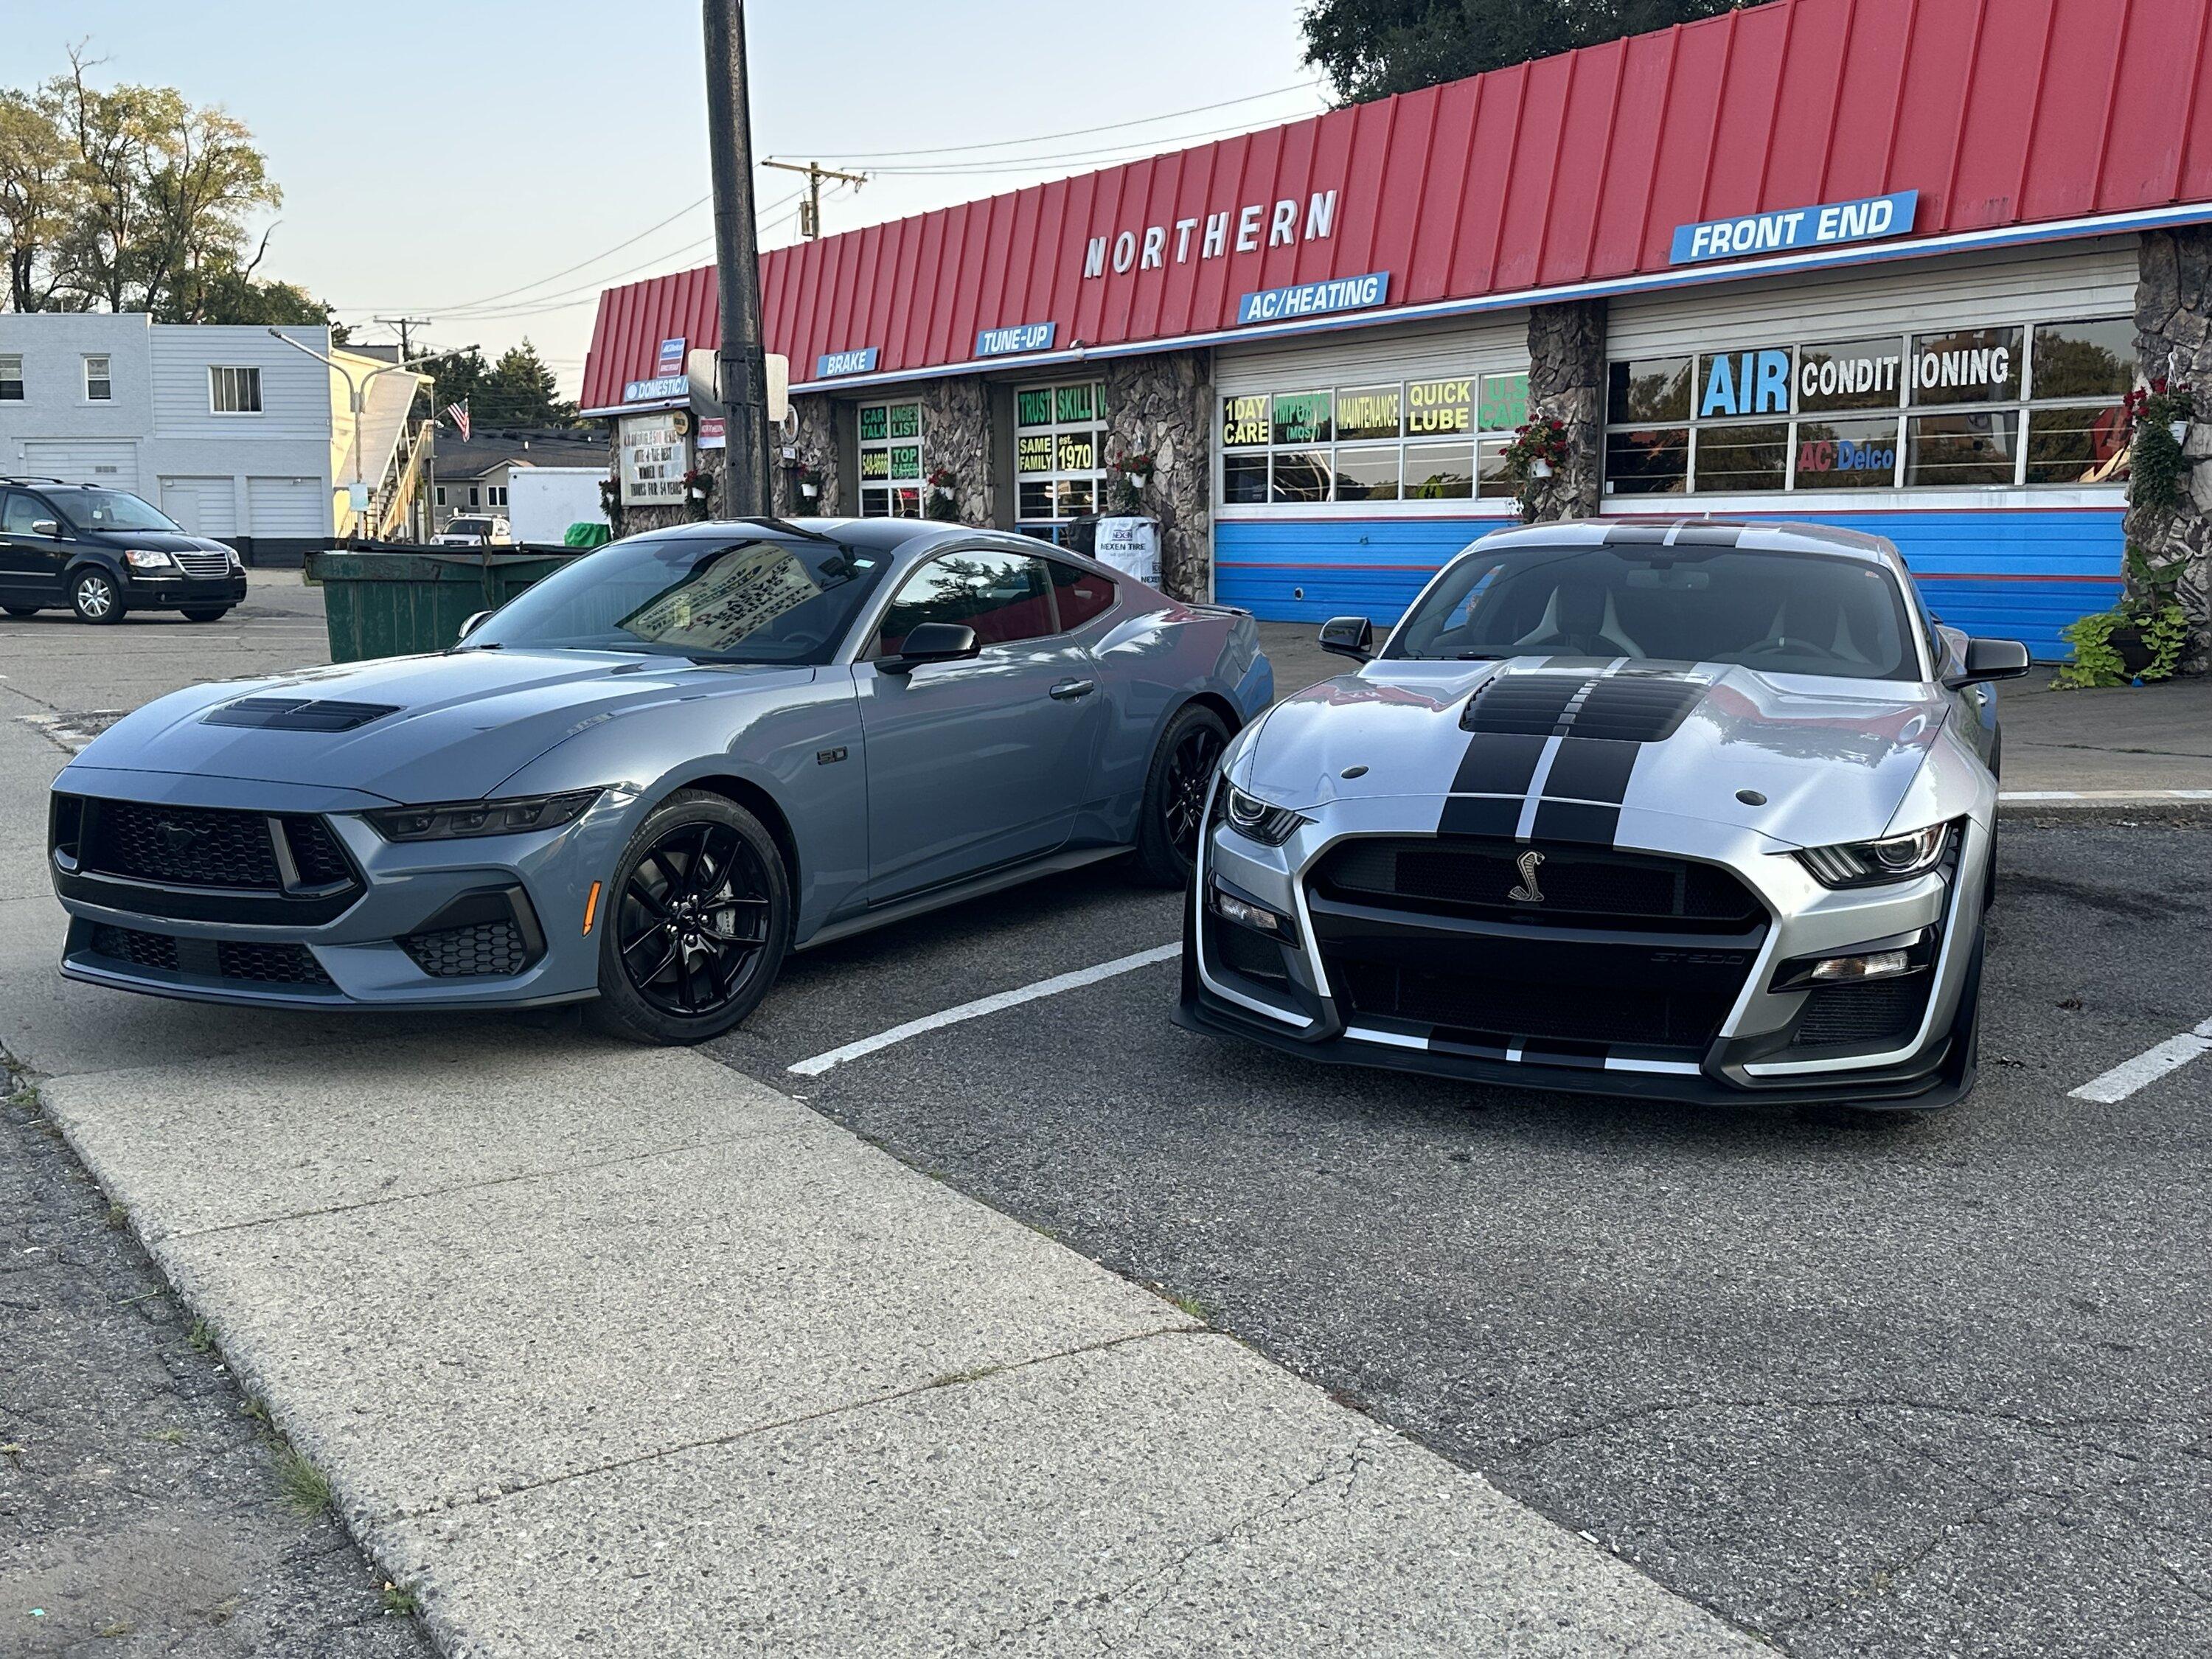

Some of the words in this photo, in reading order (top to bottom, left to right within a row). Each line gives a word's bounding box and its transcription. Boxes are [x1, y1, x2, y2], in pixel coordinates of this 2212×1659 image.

[1084, 189, 1338, 278] NORTHERN
[1691, 212, 1805, 257] FRONT
[1816, 199, 1893, 241] END
[1247, 276, 1378, 320] AC/HEATING
[983, 325, 1048, 353] TUNE-UP
[826, 351, 867, 375] BRAKE
[1410, 381, 1472, 407] QUICK
[1700, 349, 1790, 417] AIR
[863, 408, 884, 424] CAR
[1020, 391, 1051, 425] TRUST
[1057, 387, 1092, 421] SKILL
[1275, 393, 1329, 425] IMPORTS
[1338, 394, 1399, 431] MAINTENANCE
[861, 423, 888, 439] TALK
[892, 421, 918, 437] LIST
[1409, 407, 1470, 431] LUBE
[1020, 437, 1051, 454] SAME
[1224, 421, 1268, 445] CARE
[893, 448, 917, 463] TOP
[1020, 454, 1052, 470] FAMILY
[1058, 444, 1092, 470] 1970
[1100, 543, 1126, 551] NEXEN
[1128, 543, 1146, 551] TIRE
